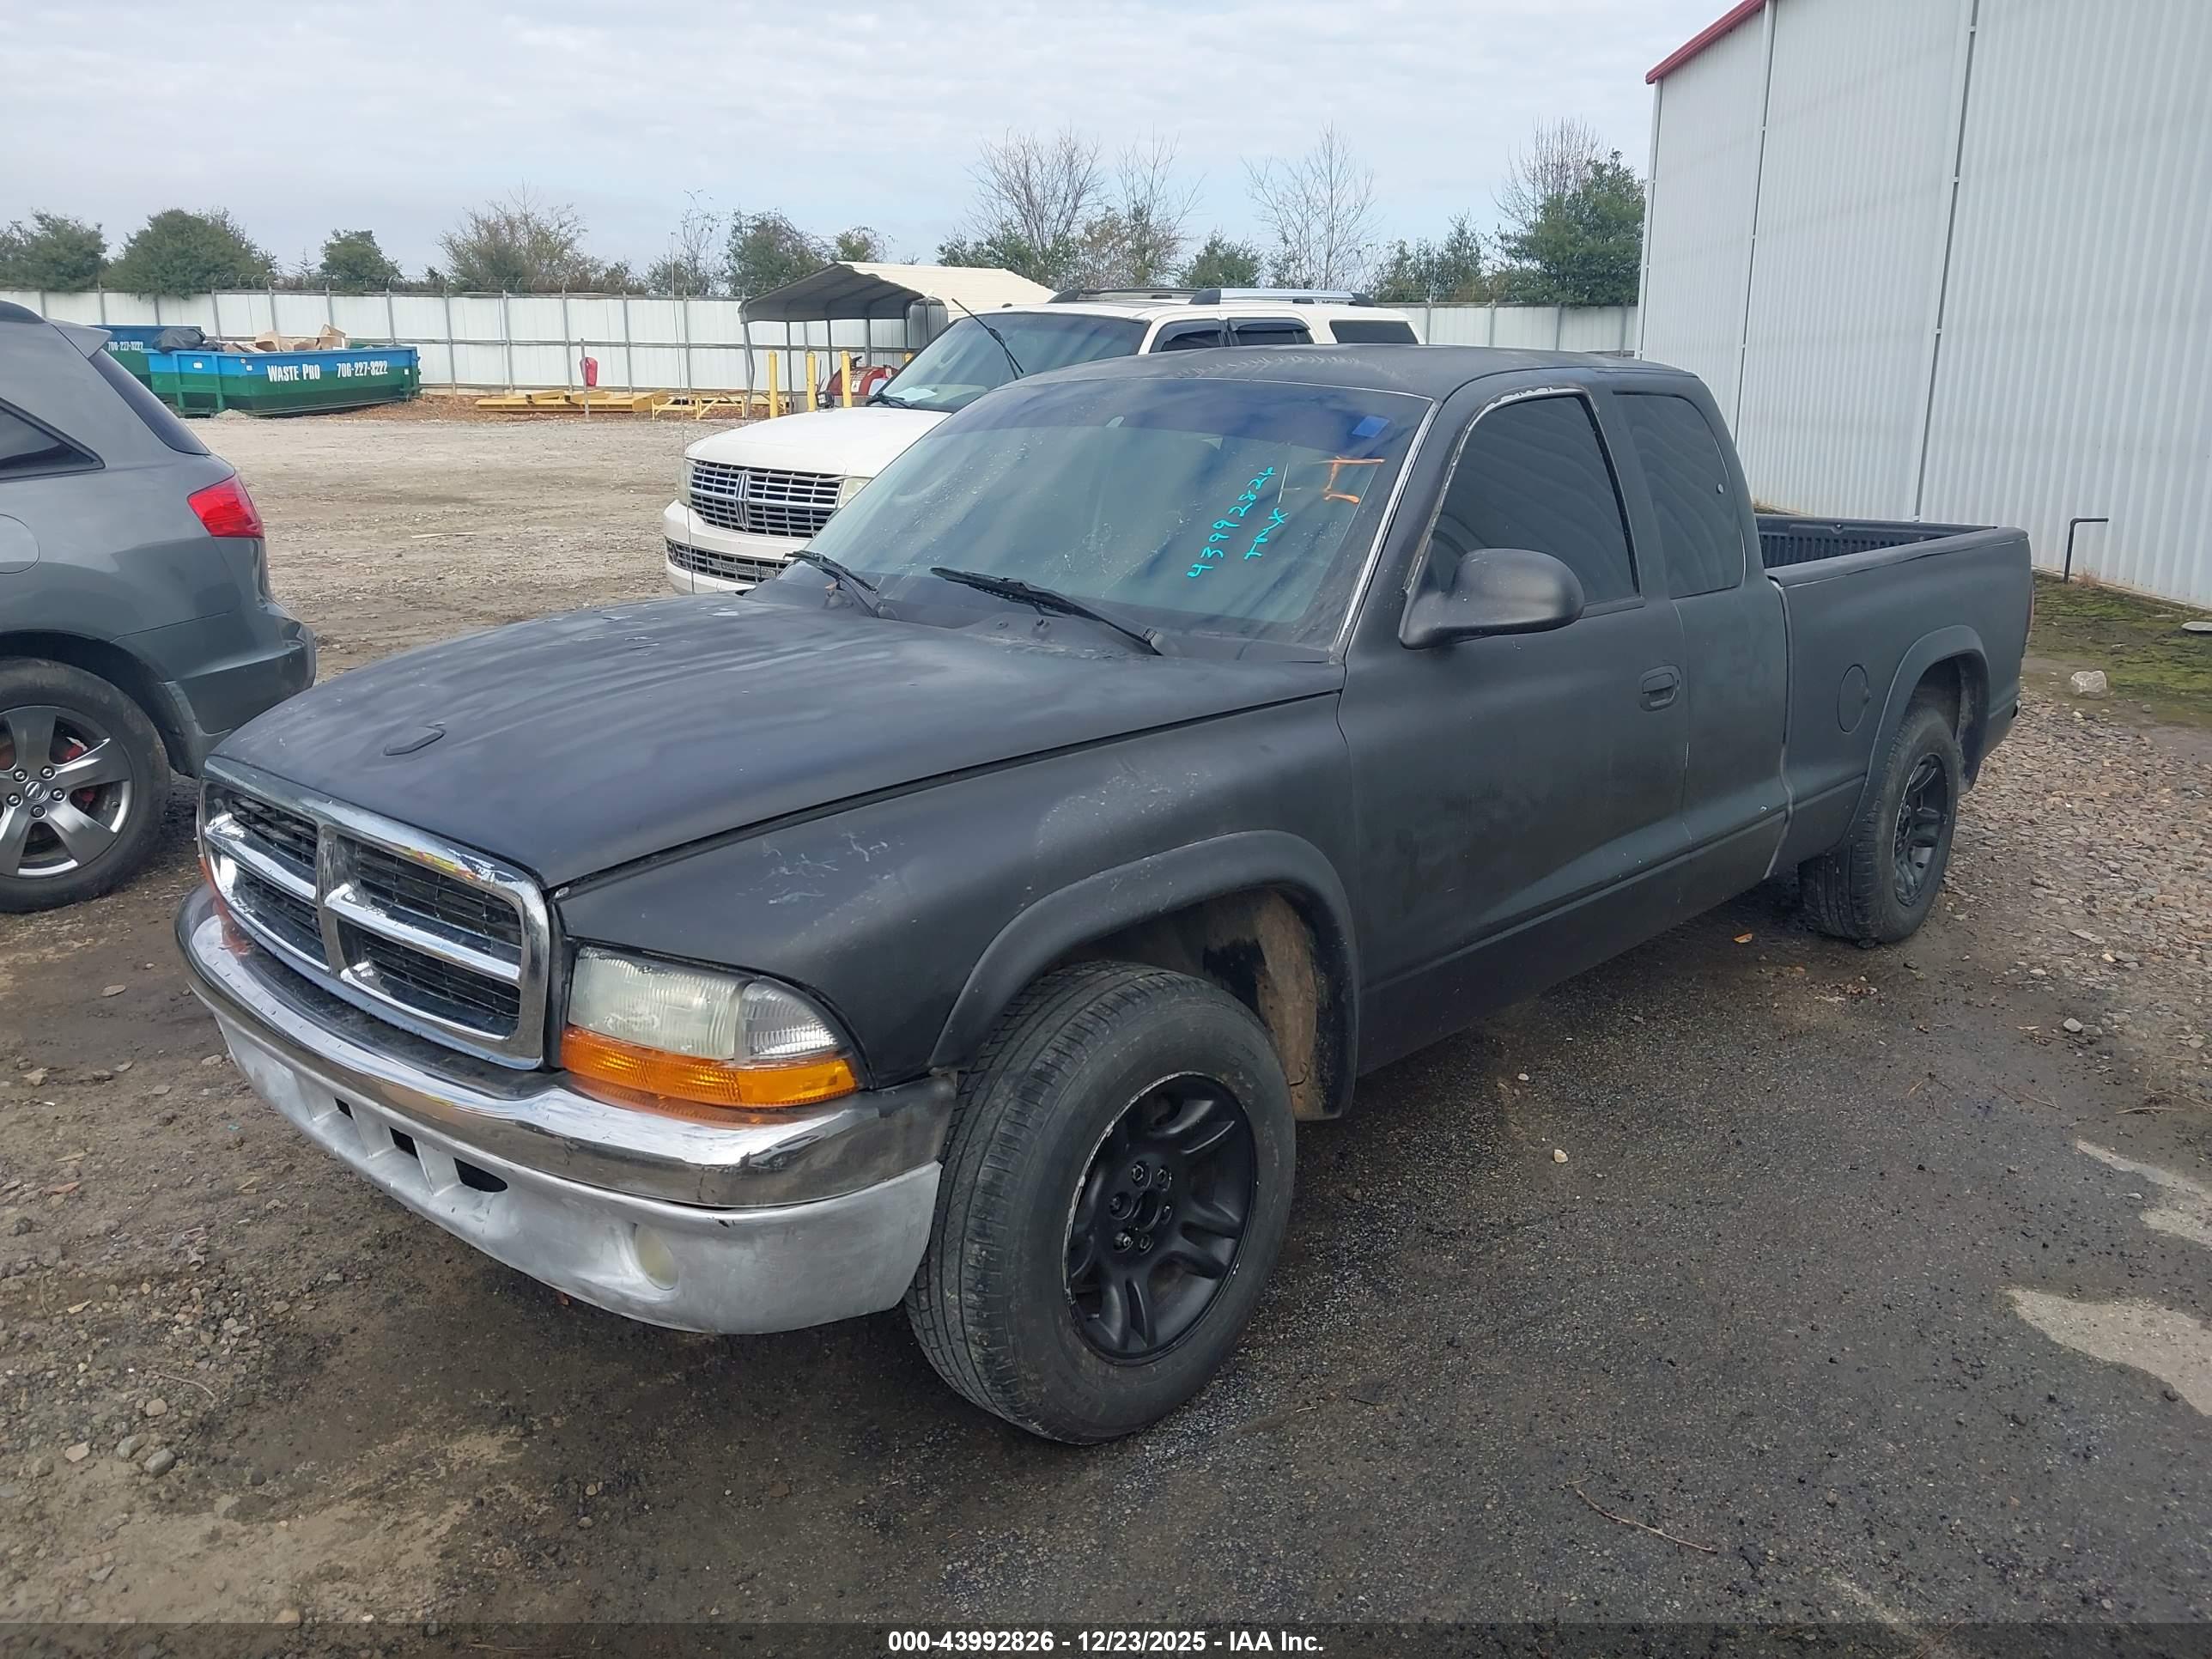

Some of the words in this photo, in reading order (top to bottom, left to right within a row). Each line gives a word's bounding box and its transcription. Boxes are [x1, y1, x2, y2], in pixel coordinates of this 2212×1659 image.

[267, 365, 299, 382] WASTE
[302, 363, 320, 380] PRO
[337, 361, 388, 378] 706-227-3222
